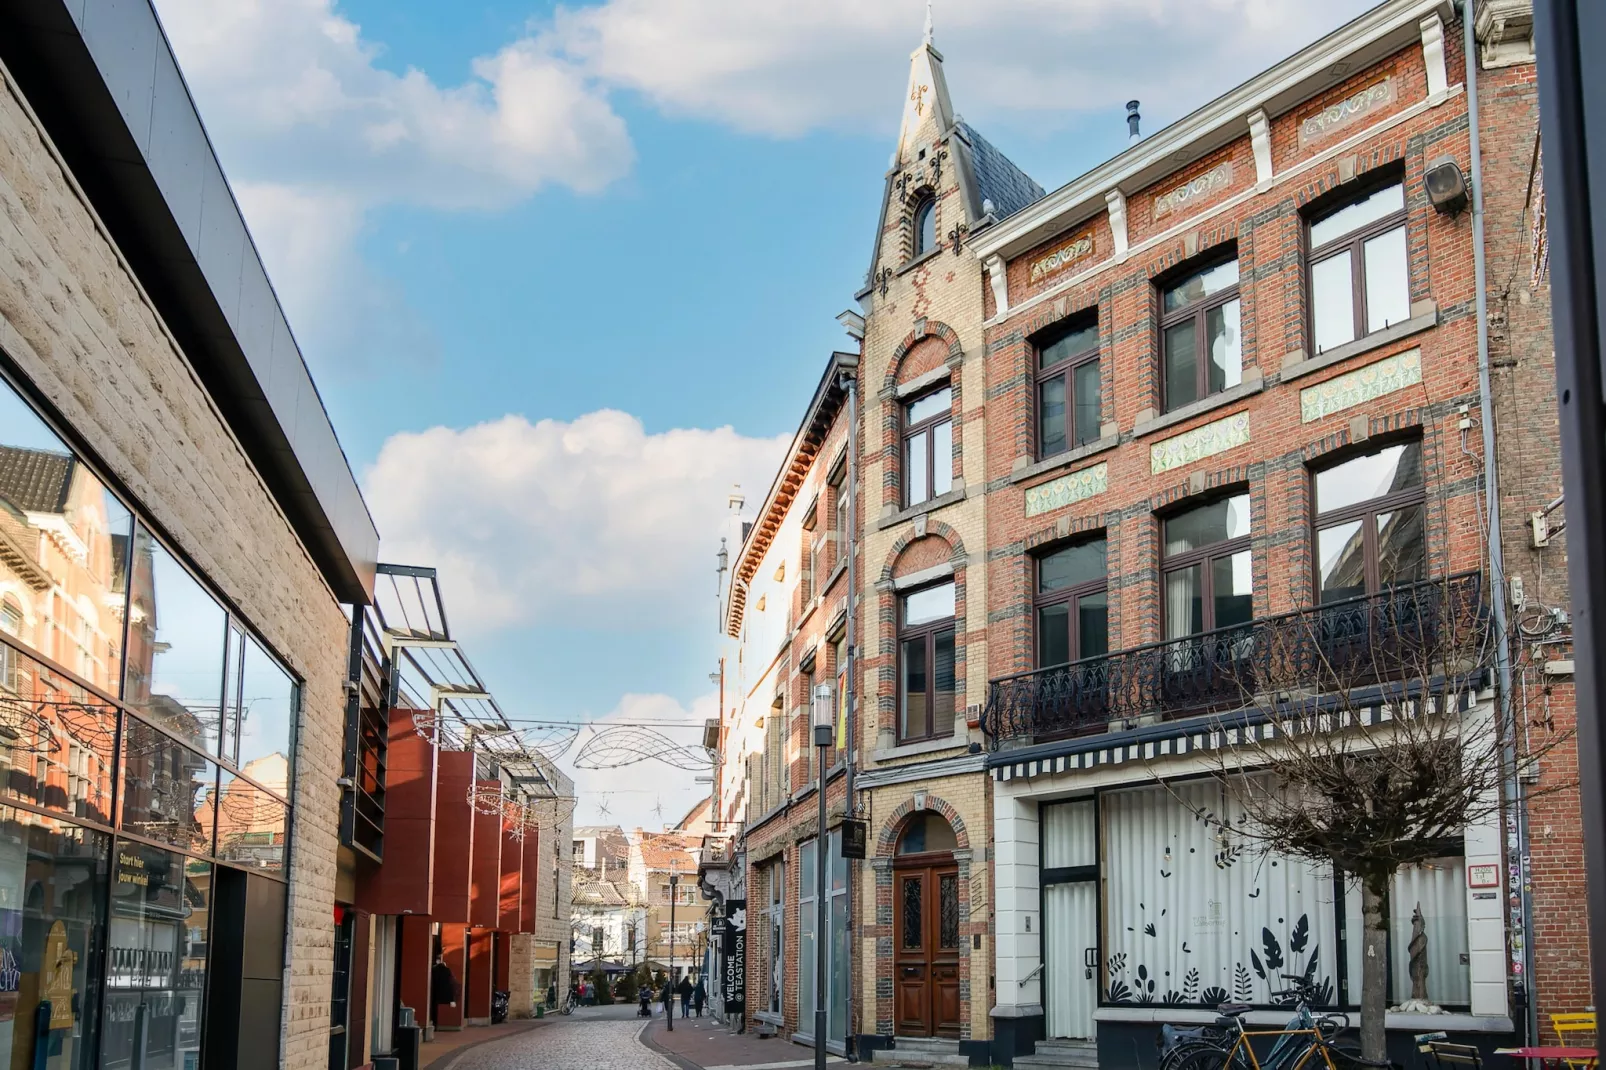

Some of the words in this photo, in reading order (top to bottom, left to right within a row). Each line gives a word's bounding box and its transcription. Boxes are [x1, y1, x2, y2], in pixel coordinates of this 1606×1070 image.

[119, 852, 134, 867] Start
[134, 856, 145, 869] hier
[117, 869, 132, 885] jouw
[132, 872, 149, 887] winkel
[734, 935, 744, 992] TEASTATION
[726, 955, 735, 1003] WELCOME
[734, 992, 745, 1003] @
